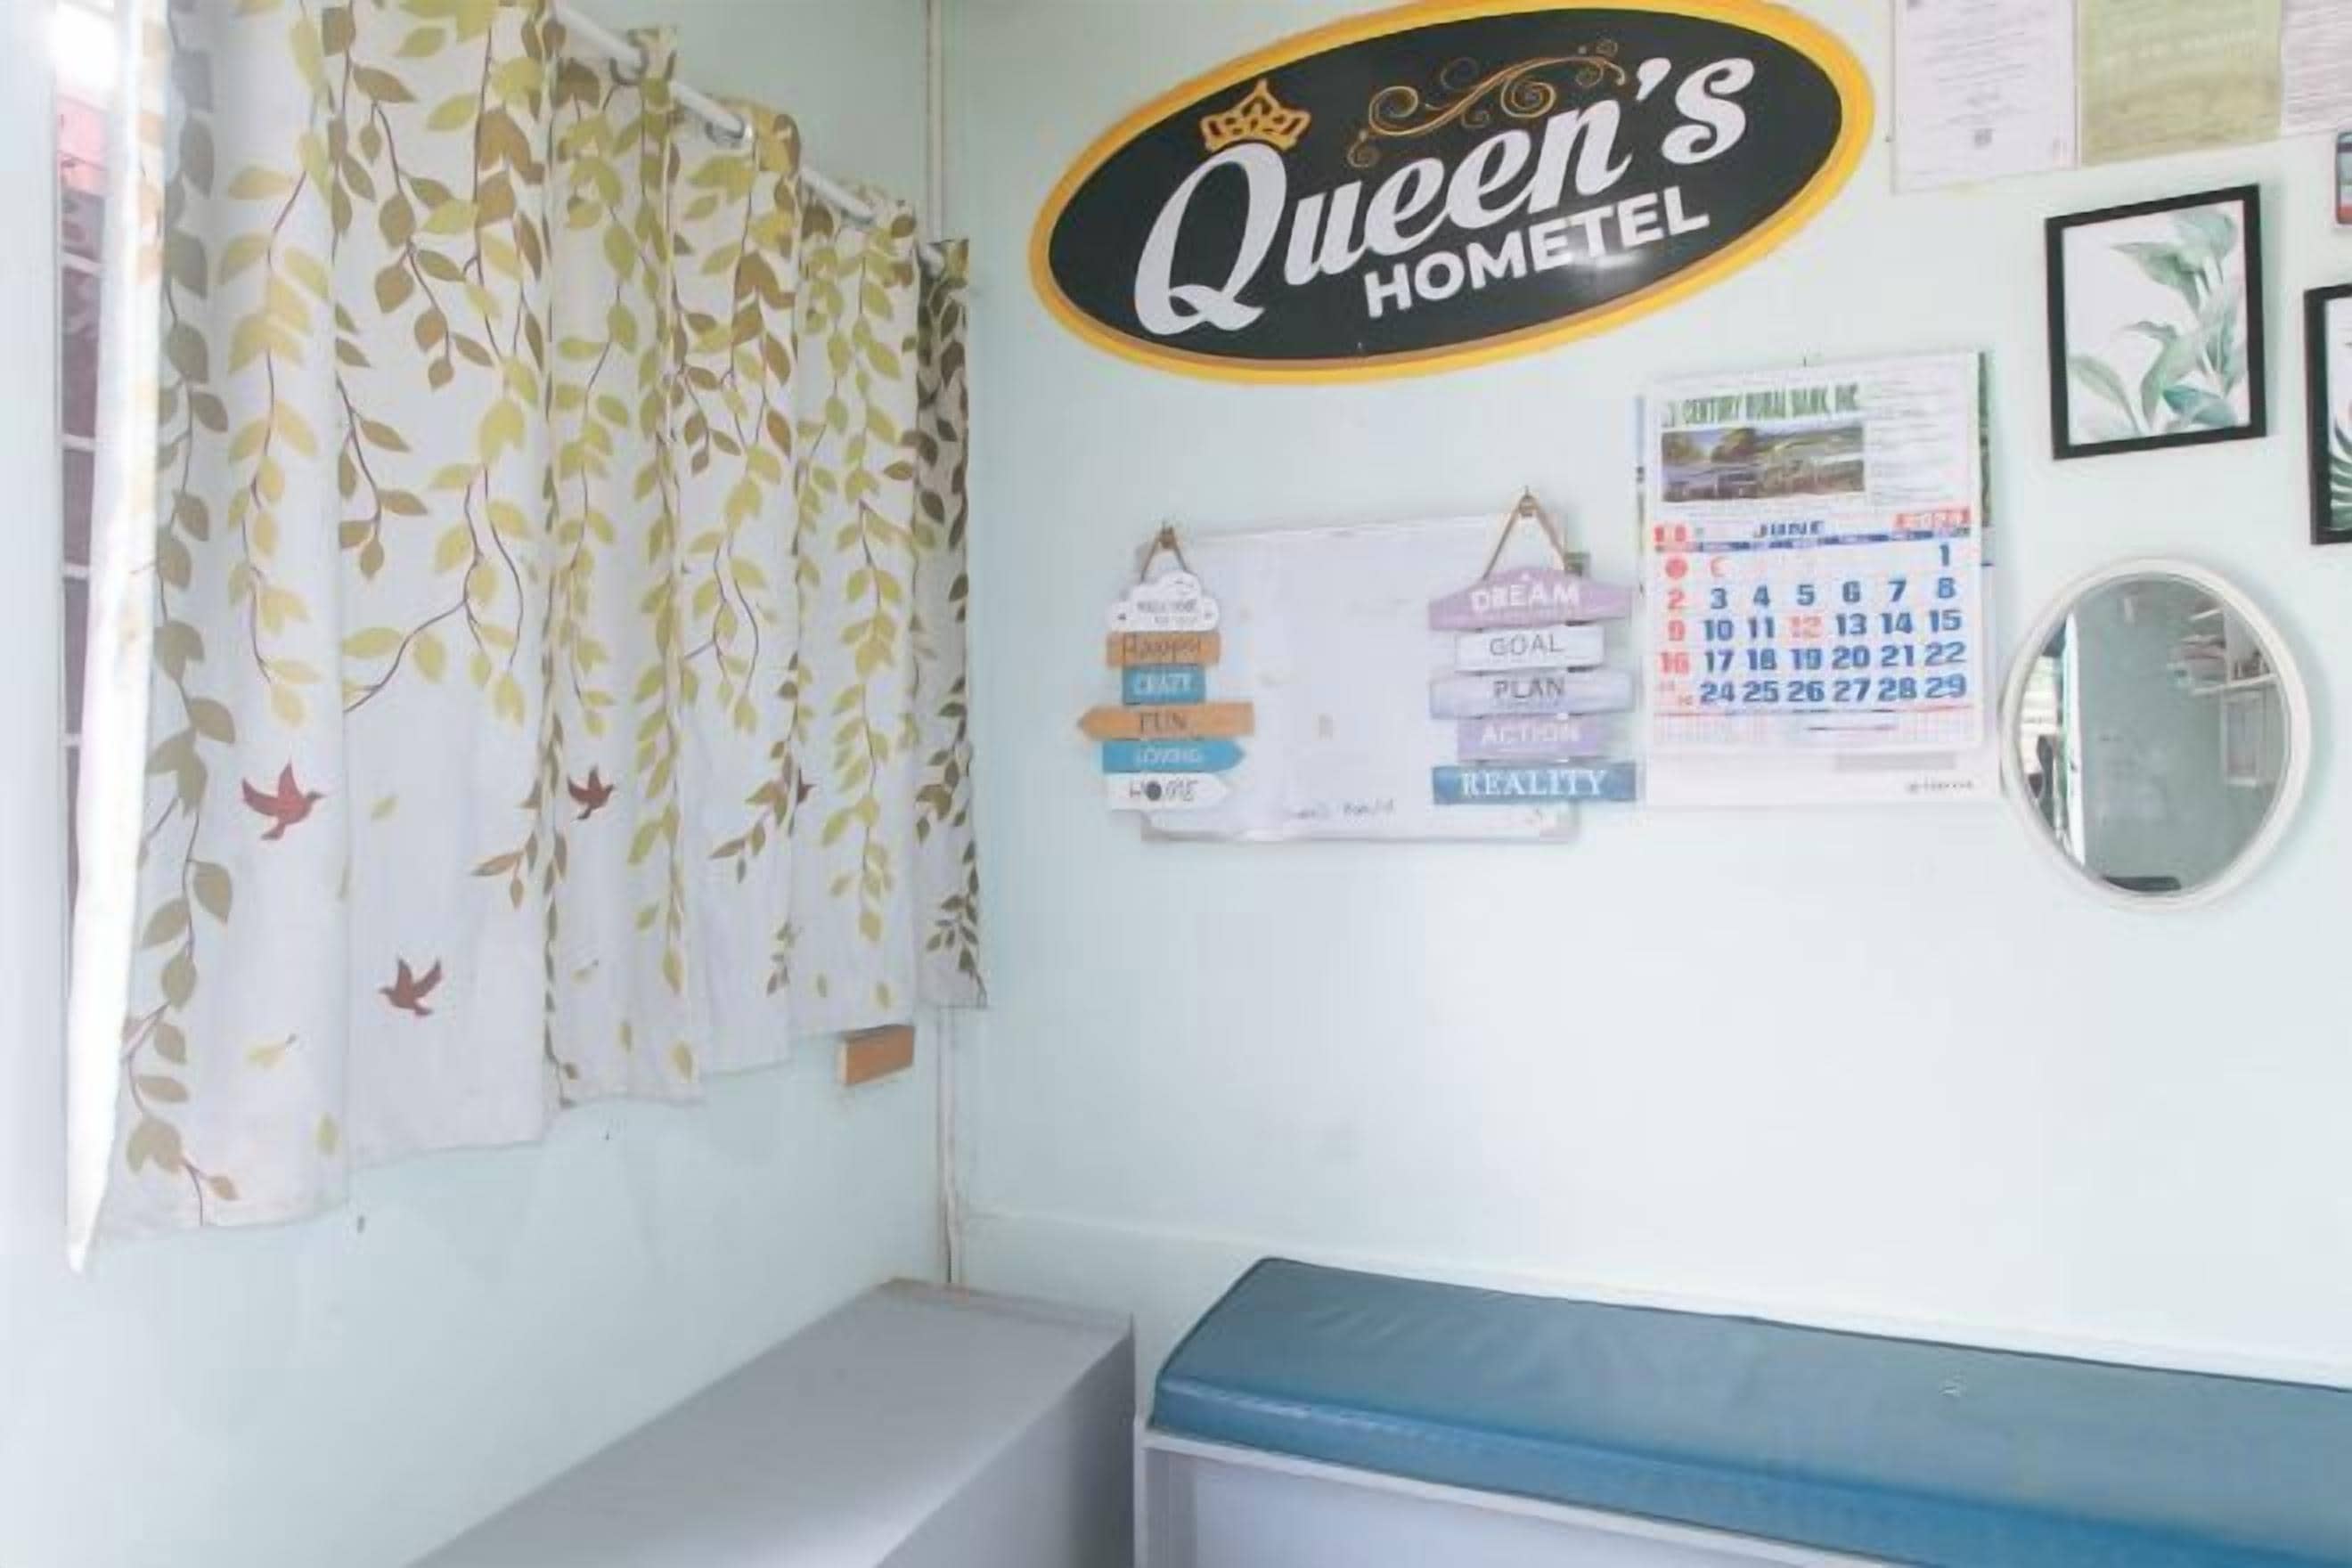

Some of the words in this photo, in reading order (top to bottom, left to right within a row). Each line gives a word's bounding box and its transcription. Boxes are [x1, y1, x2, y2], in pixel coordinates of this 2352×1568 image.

[1134, 57, 1755, 335] Queen's
[1364, 185, 1711, 318] HOMETEL
[1754, 519, 1825, 538] JUNE
[1940, 543, 1951, 567] 1
[1470, 583, 1581, 615] DREAM
[1667, 590, 1686, 611] 2
[1710, 587, 1729, 610] 3
[1752, 584, 1771, 608] 4
[1796, 584, 1817, 607] 5
[1842, 581, 1861, 604] 6
[1888, 578, 1907, 603] 7
[1937, 576, 1956, 600] 8
[1668, 619, 1686, 642] 9
[1703, 619, 1735, 642] 10
[1748, 617, 1776, 640] 11
[1787, 615, 1823, 639] 12
[1835, 613, 1867, 637] 13
[1881, 611, 1914, 635] 14
[1929, 609, 1962, 633] 15
[1489, 633, 1565, 657] GOAL
[1660, 651, 1690, 675] 16
[1704, 650, 1735, 674] 17
[1747, 648, 1778, 672] 18
[1790, 647, 1823, 671] 19
[1832, 645, 1870, 670] 20
[1881, 644, 1915, 668] 21
[1924, 641, 1966, 666] 22
[1493, 677, 1566, 700] PLAN
[1700, 682, 1735, 705] 24
[1742, 680, 1780, 704] 25
[1786, 680, 1825, 703] 26
[1833, 677, 1871, 702] 27
[1878, 676, 1917, 701] 28
[1924, 674, 1967, 699] 29
[1481, 719, 1581, 744] ACTION
[1460, 769, 1608, 797] REALITY
